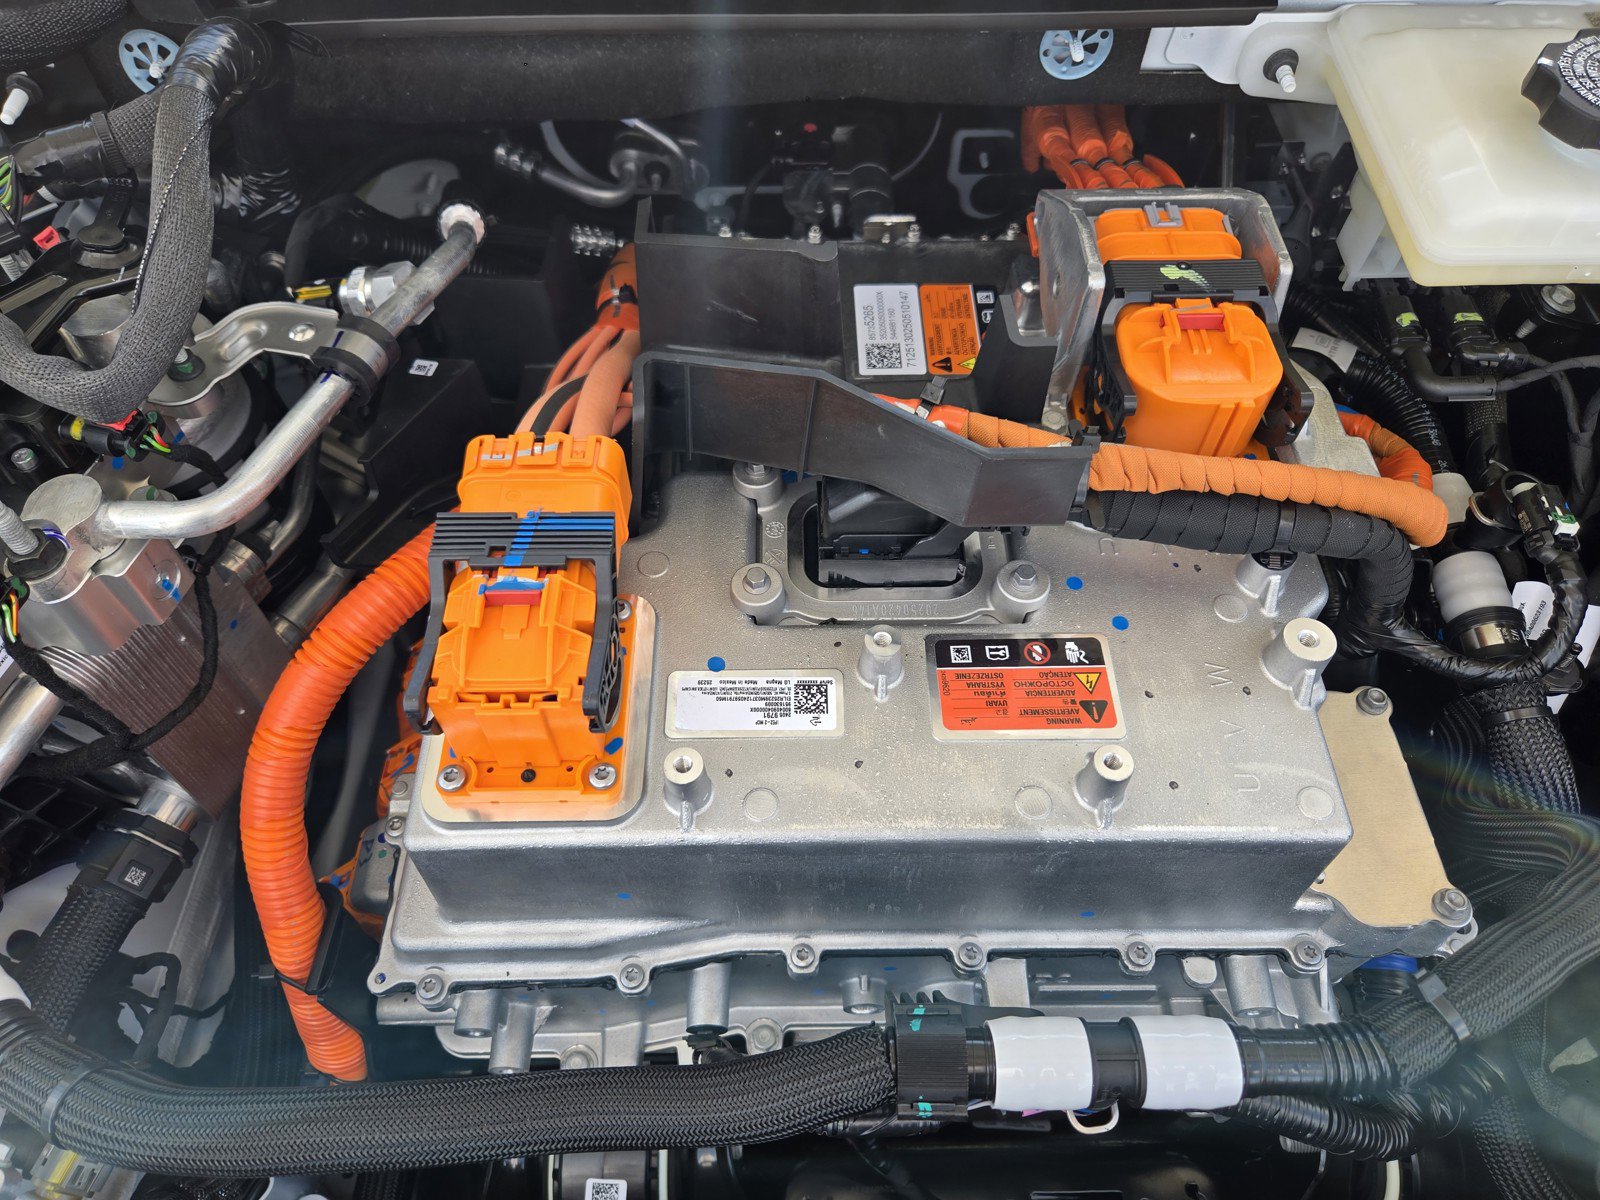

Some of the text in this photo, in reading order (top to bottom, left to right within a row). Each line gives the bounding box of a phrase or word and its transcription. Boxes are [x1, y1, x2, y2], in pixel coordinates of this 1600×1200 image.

[955, 671, 1004, 680] OSTRZEŻENIE
[1039, 670, 1072, 680] ATENÇÃO
[966, 681, 1006, 690] VÝSTRAHA
[1013, 680, 1075, 688] ОСТОРОЖНО
[1025, 689, 1076, 697] ADVERTENCIA
[986, 699, 1008, 707] UYARI
[1019, 708, 1080, 716] AVERTISSEMENT
[1046, 717, 1083, 725] WARNING
